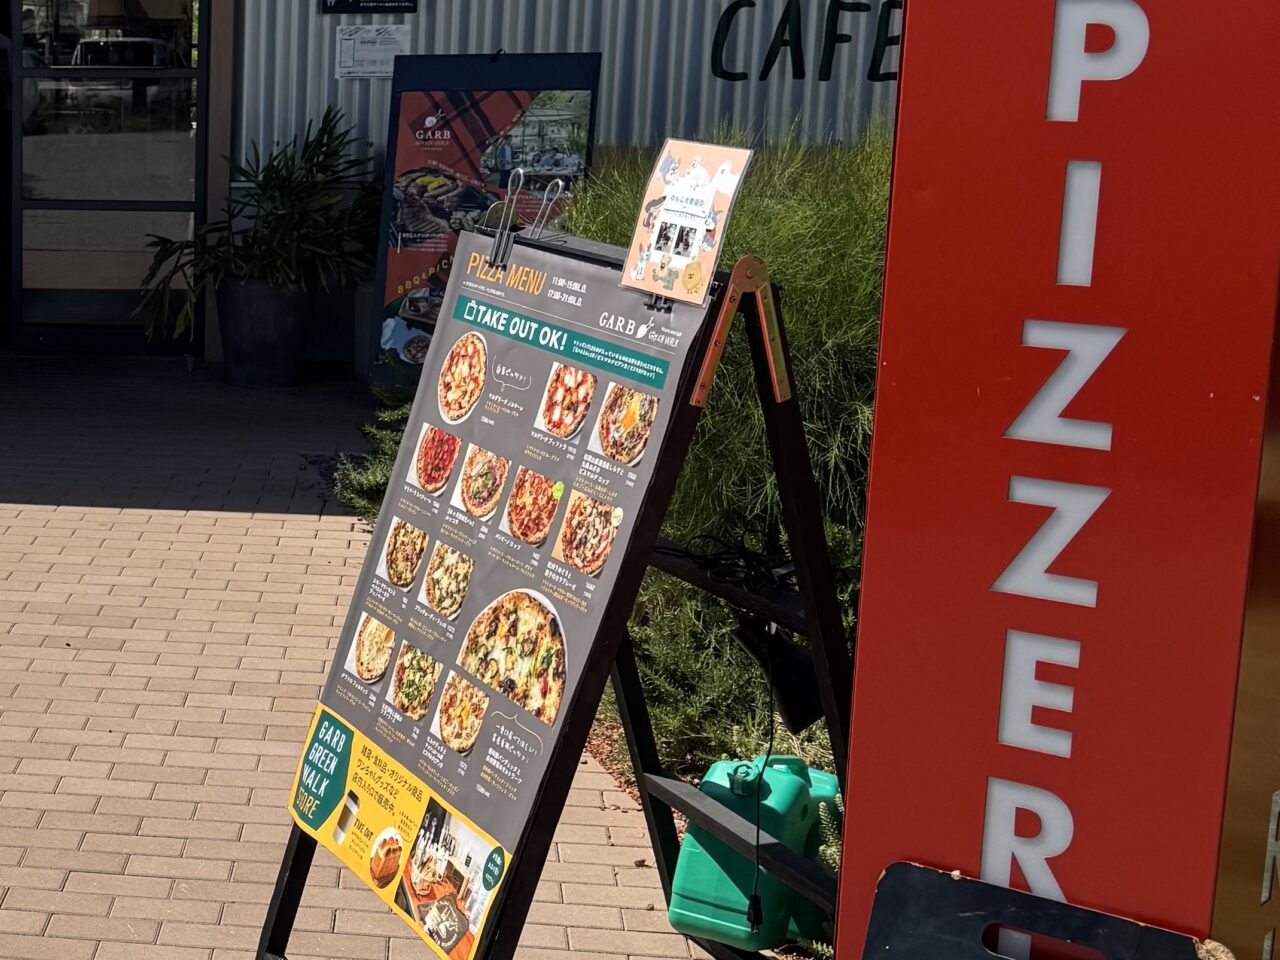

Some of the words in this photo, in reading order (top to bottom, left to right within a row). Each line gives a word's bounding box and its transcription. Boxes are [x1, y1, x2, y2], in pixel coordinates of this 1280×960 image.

[416, 130, 450, 139] GARB
[466, 251, 504, 284] PIZZA
[505, 264, 547, 295] MENU
[477, 305, 508, 331] TAKE
[509, 317, 538, 340] OUT
[539, 327, 568, 351] OK!
[599, 312, 636, 335] GARB
[319, 721, 346, 753] GARB
[308, 742, 338, 776] GREEN
[302, 763, 329, 798] WALK
[297, 786, 320, 819] STORE
